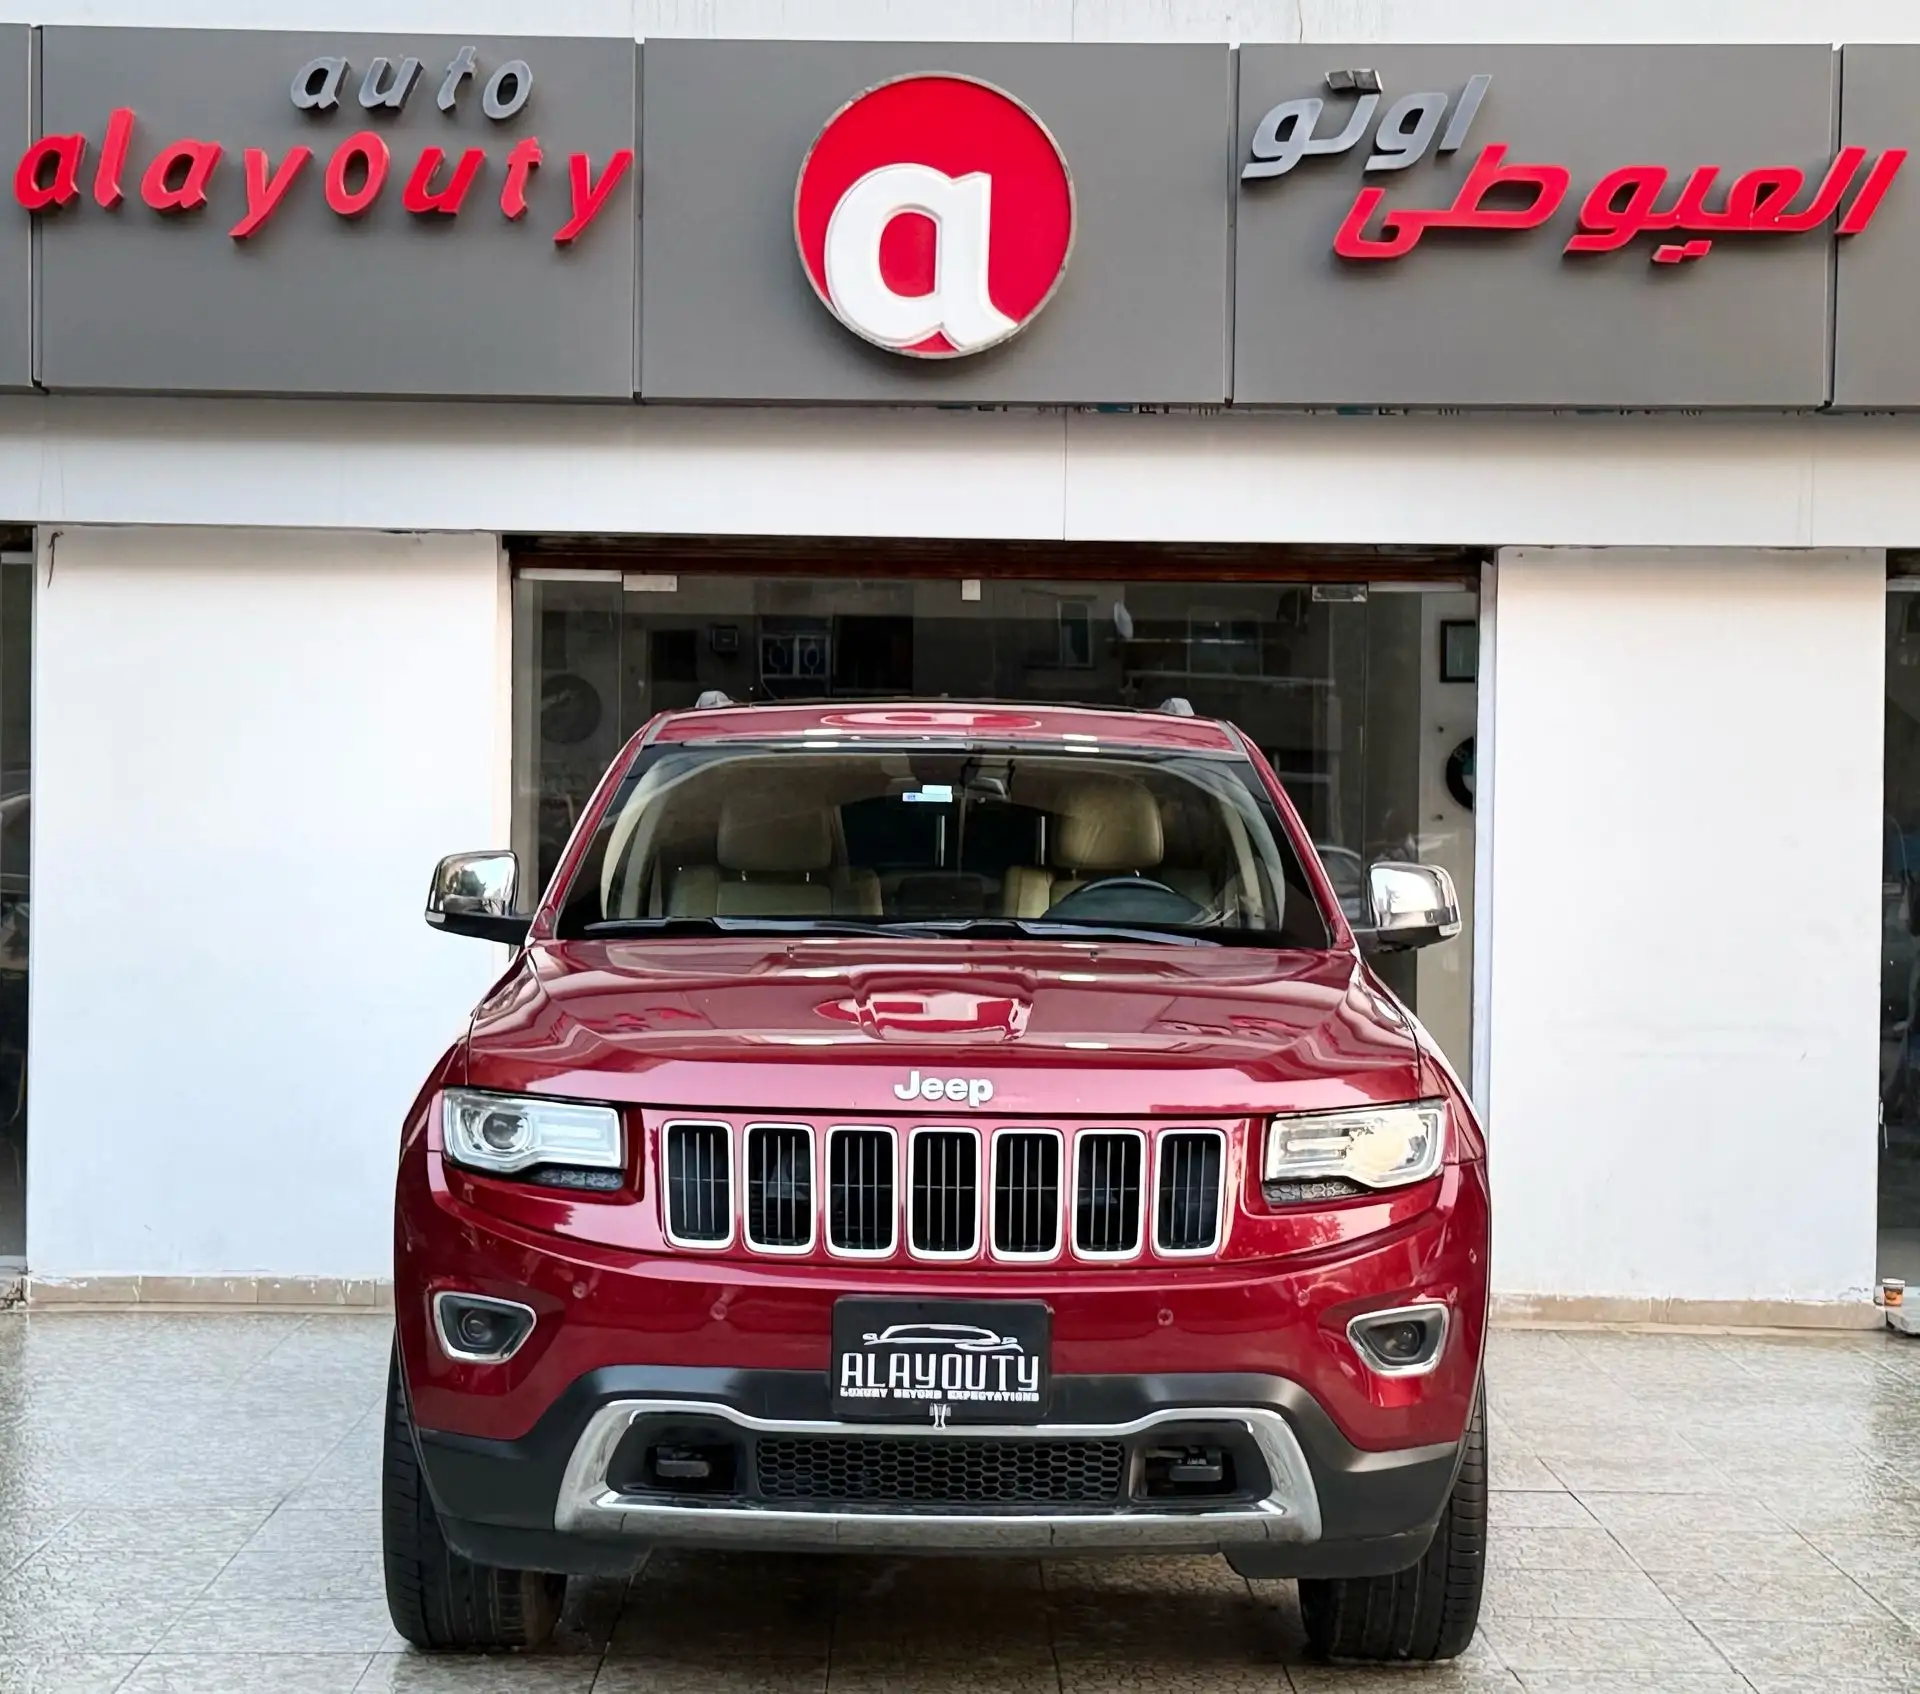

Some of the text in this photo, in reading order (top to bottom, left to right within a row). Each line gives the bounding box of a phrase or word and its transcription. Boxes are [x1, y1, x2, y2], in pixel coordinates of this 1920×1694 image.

[289, 45, 534, 121] auto
[1240, 67, 1493, 182] اوتو
[823, 162, 1018, 352] a
[893, 1070, 994, 1108] Jeep
[839, 1386, 888, 1399] LUXURY
[840, 1352, 1039, 1392] ALAYOUTY
